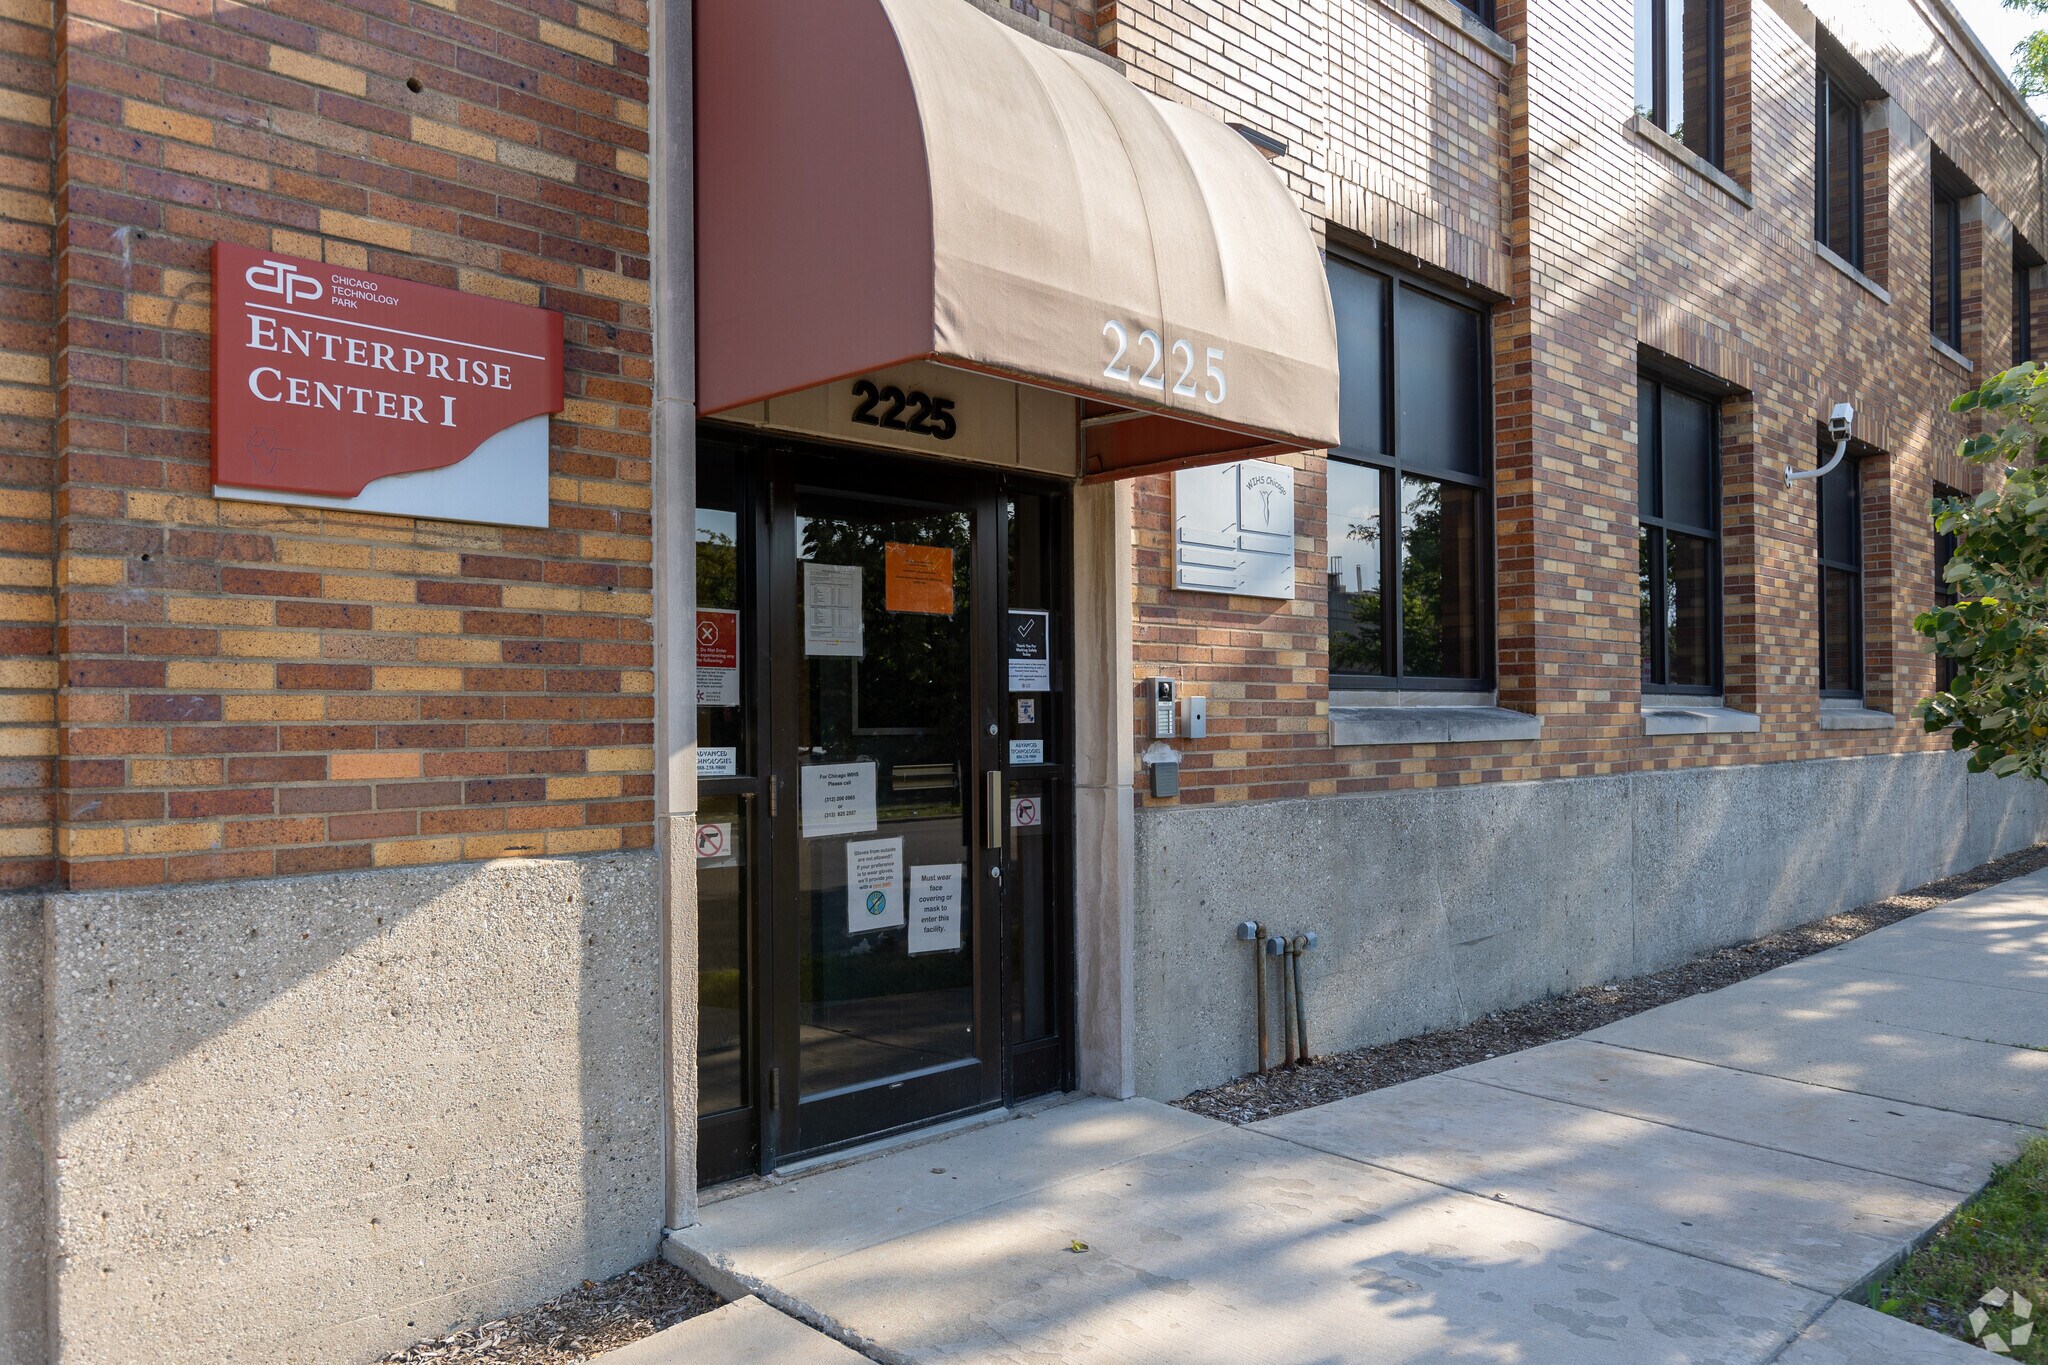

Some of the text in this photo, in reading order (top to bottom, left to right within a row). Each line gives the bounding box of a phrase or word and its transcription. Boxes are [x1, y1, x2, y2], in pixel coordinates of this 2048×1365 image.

[331, 274, 379, 292] CHICAGO
[331, 285, 400, 306] TECHNOLOGY
[331, 296, 358, 310] PARK
[245, 314, 513, 391] ENTERPRISE
[1102, 319, 1228, 405] 2225
[248, 366, 457, 428] CENTER I
[851, 379, 957, 441] 2225
[1246, 476, 1287, 496] WIHS Chicago
[924, 925, 946, 933] facility.
